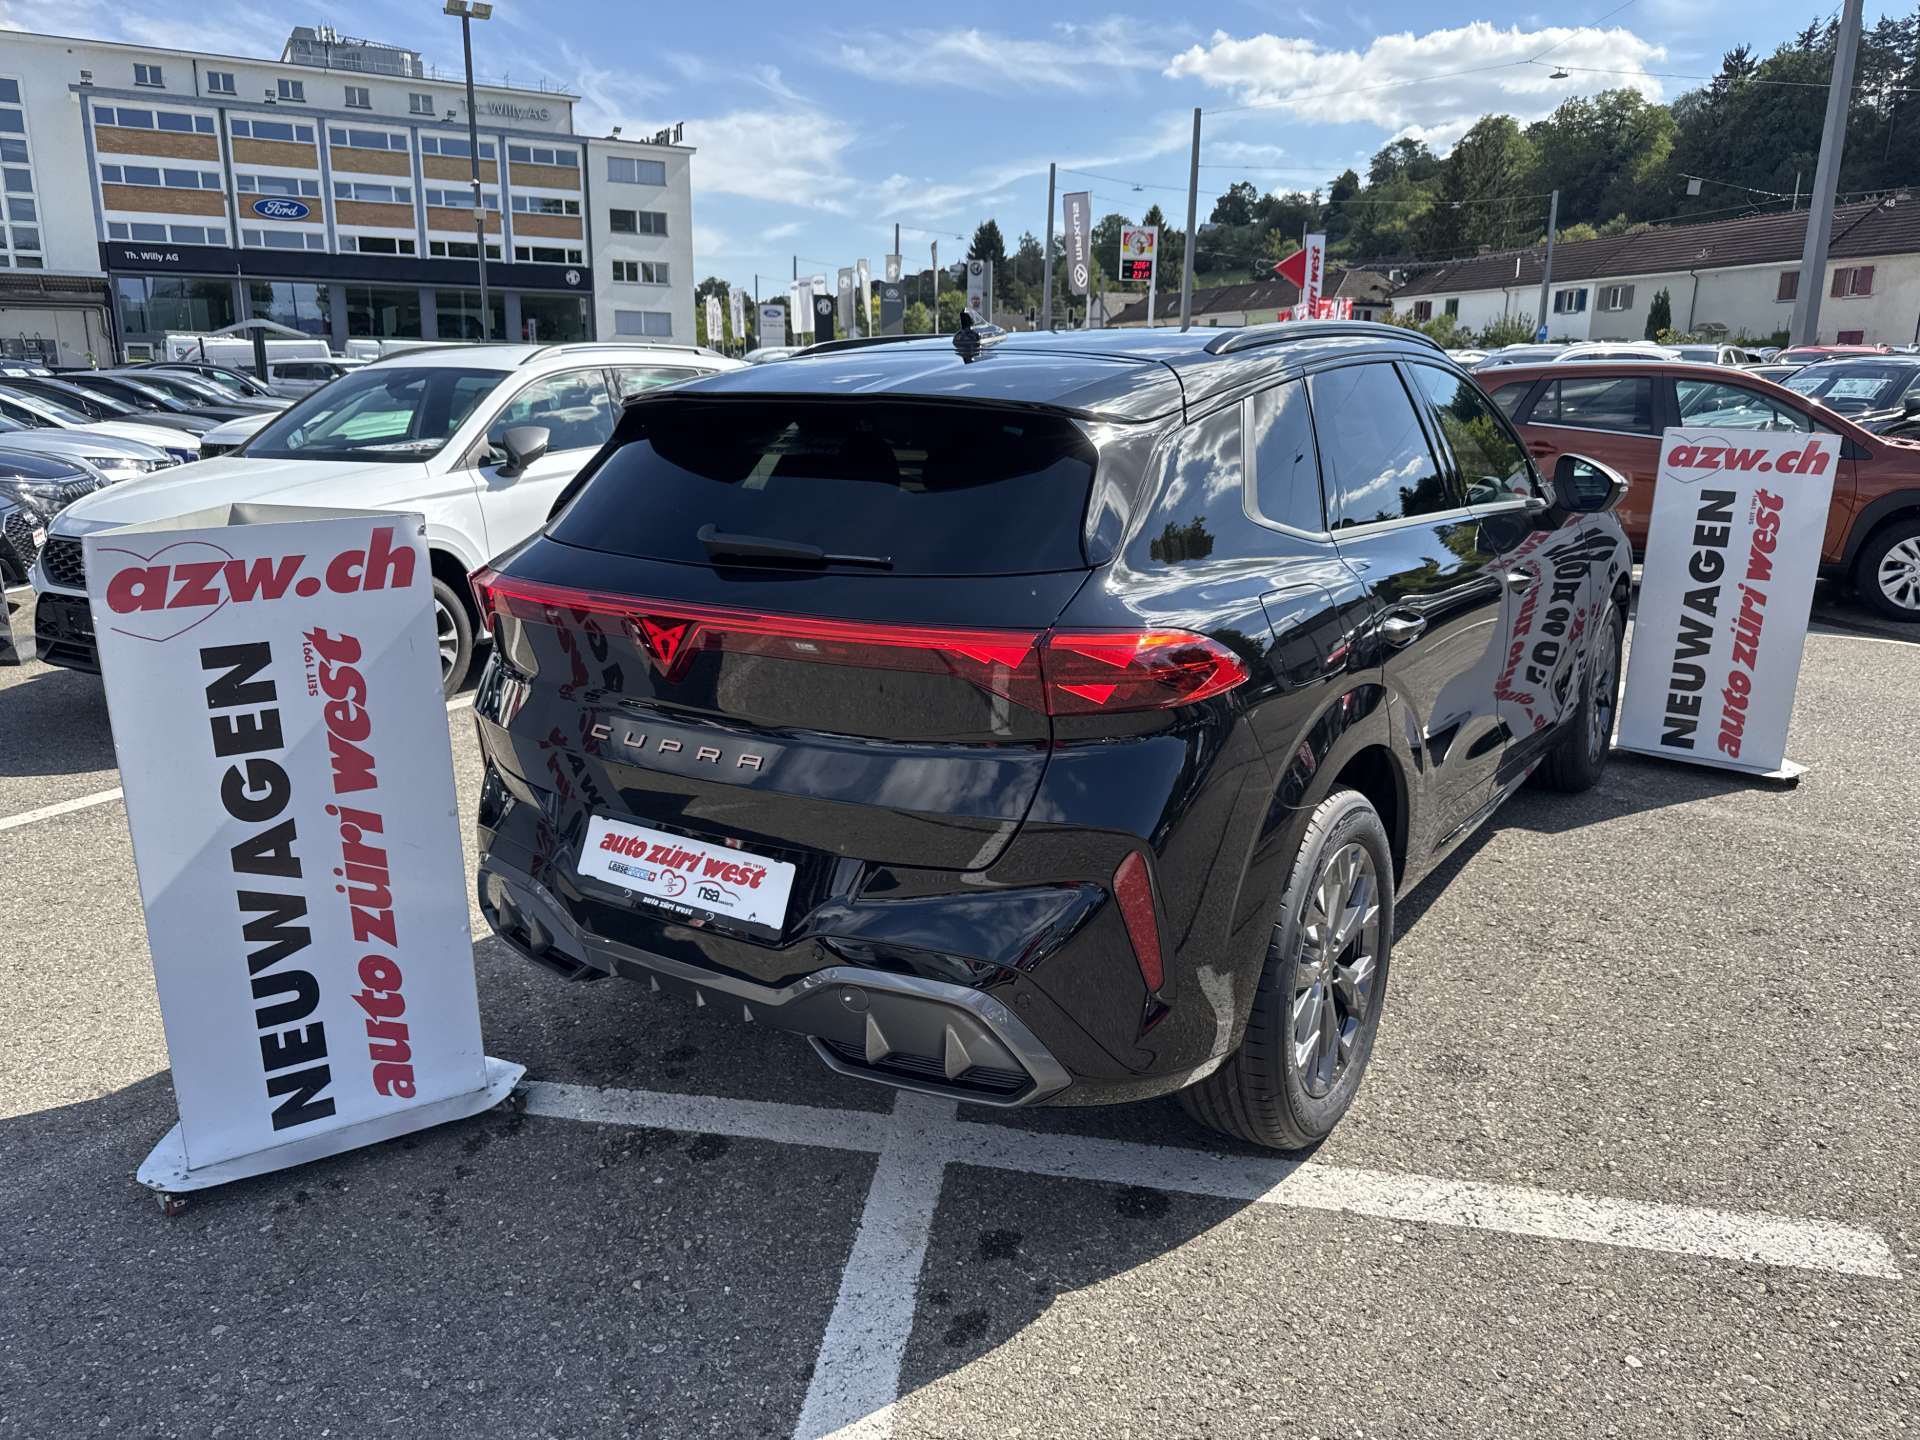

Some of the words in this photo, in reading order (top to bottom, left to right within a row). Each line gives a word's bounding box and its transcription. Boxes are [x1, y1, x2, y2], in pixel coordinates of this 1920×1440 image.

[487, 103, 521, 120] Willy
[528, 105, 551, 120] AG
[264, 200, 298, 216] Ford
[124, 250, 139, 260] Th.
[140, 251, 163, 262] Willy
[166, 253, 179, 261] AG
[1666, 440, 1830, 475] azw.ch
[1746, 487, 1785, 581] west
[107, 527, 416, 615] azw.ch
[1660, 489, 1737, 750] NEUWAGEN
[1730, 582, 1767, 671] züri
[303, 642, 315, 668] 1991
[302, 626, 378, 795] west
[307, 673, 319, 697] SEIT
[1718, 669, 1752, 759] auto
[591, 723, 765, 771] CUPRA
[199, 641, 336, 1131] NEUWAGEN
[323, 801, 398, 948] züri
[600, 832, 649, 859] auto
[644, 844, 706, 873] züri
[702, 855, 768, 889] west
[642, 896, 659, 906] auto
[675, 905, 694, 915] west
[697, 886, 720, 903] nsa
[350, 953, 416, 1099] auto
